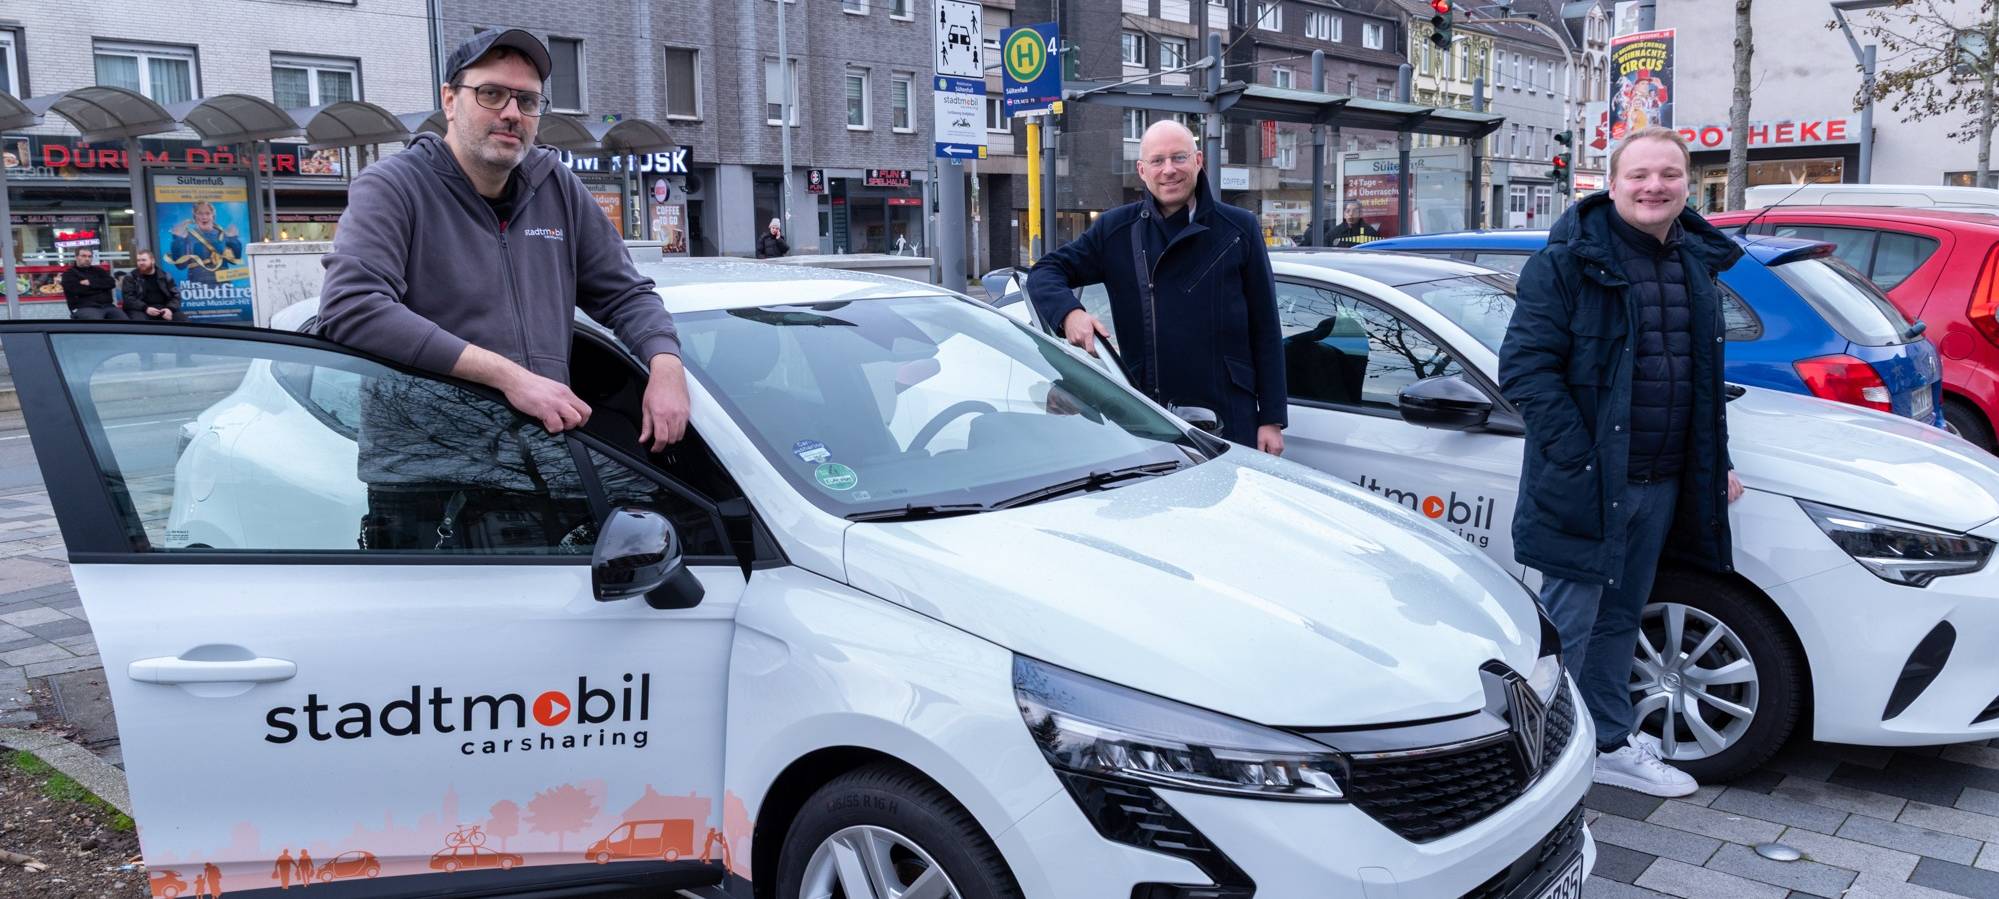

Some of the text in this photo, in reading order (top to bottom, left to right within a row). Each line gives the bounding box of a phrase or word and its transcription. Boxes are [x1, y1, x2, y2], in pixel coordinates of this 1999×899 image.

[1017, 43, 1034, 68] H
[1047, 37, 1057, 56] 4
[1620, 58, 1664, 75] CIRCUS
[1678, 120, 1846, 147] POHEKE
[177, 176, 224, 186] Sültenfuß
[880, 170, 899, 178] FUN
[655, 206, 680, 216] COFFEE
[180, 283, 250, 300] oubtfire
[264, 673, 651, 744] stadtmobil
[460, 728, 649, 755] carsharing
